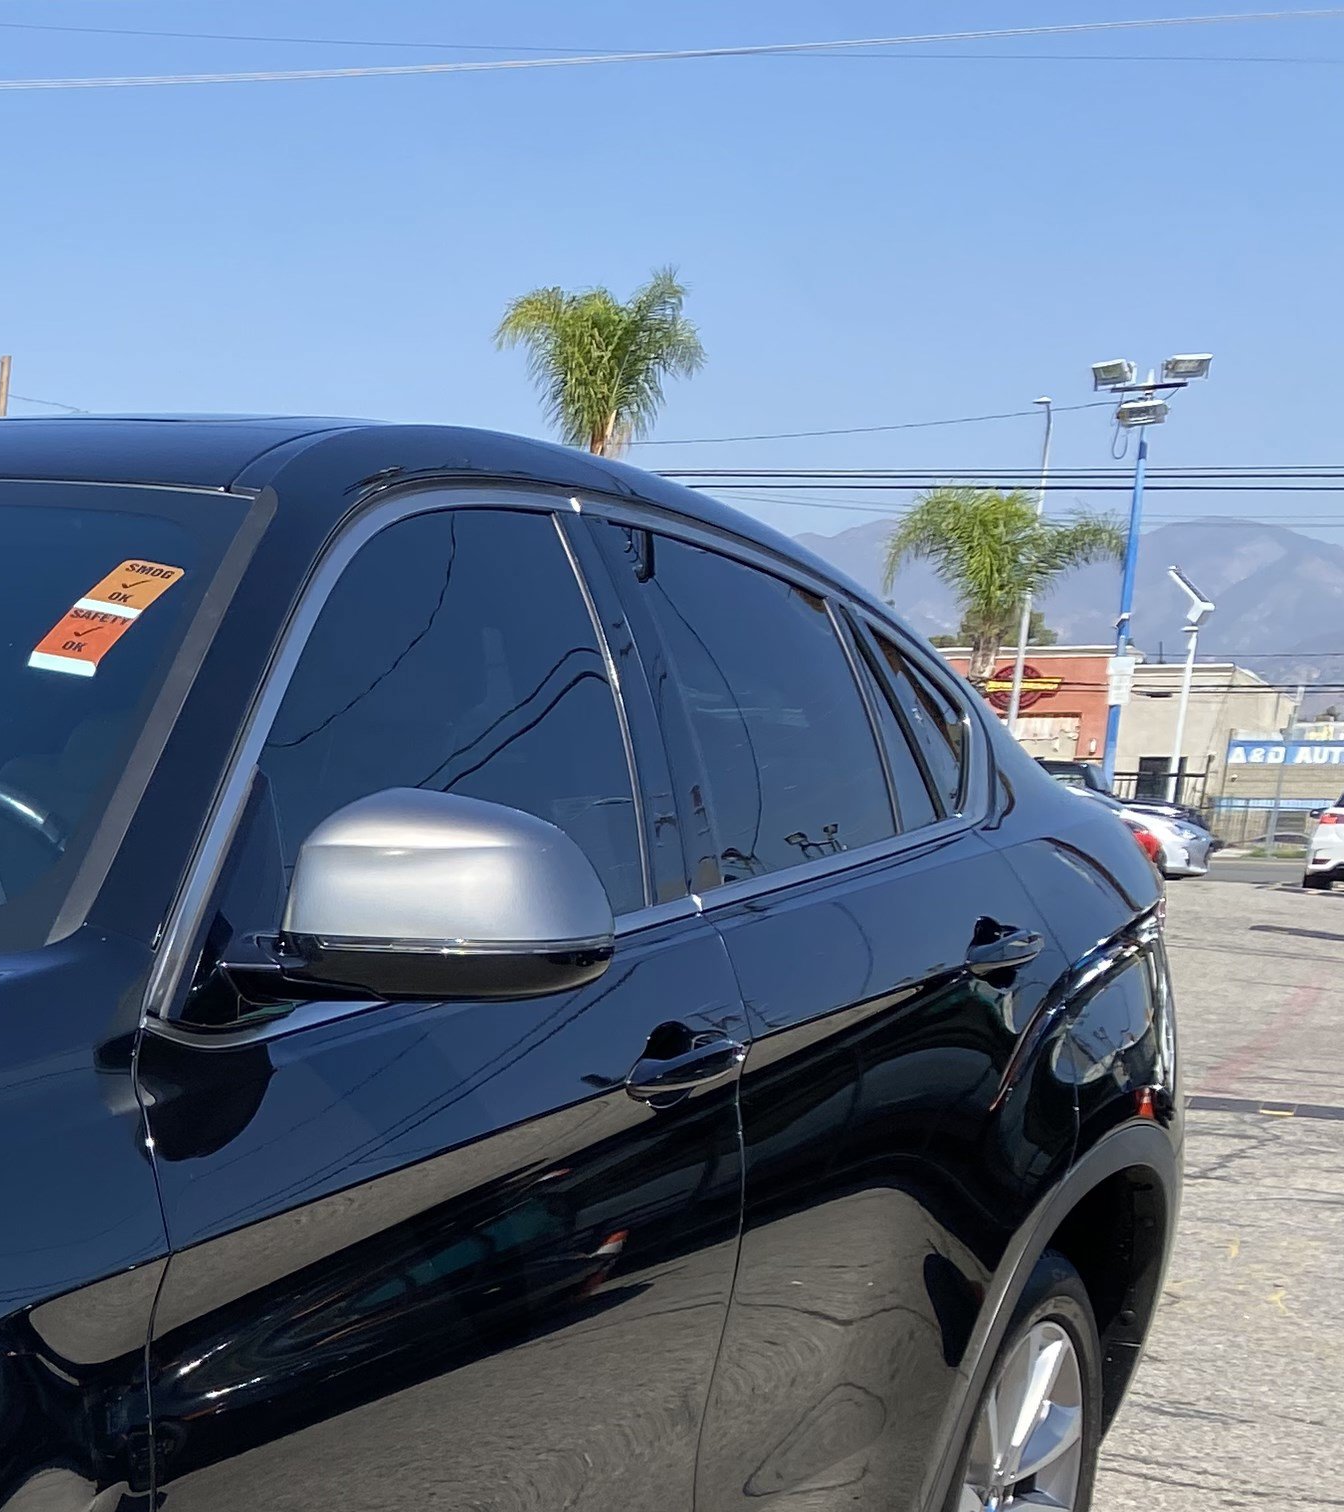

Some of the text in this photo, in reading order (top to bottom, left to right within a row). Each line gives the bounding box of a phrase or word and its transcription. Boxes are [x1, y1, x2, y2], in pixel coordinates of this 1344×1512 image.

[125, 563, 175, 580] SMOG
[107, 591, 134, 604] OK
[70, 608, 134, 626] SAFETY
[62, 640, 89, 653] OK
[1228, 746, 1286, 764] A&D
